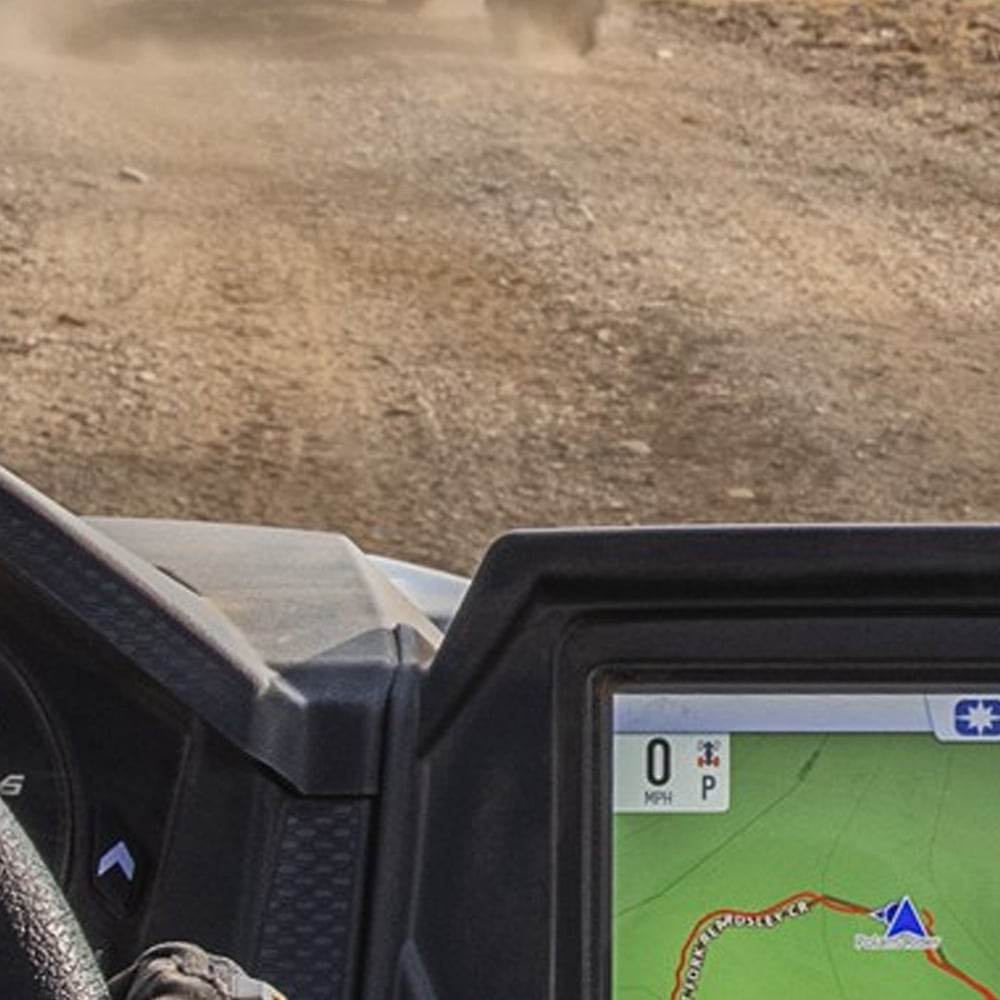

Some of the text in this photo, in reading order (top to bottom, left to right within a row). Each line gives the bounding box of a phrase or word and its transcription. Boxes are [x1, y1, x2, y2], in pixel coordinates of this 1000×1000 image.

[646, 738, 671, 786] 0
[644, 792, 672, 805] MPH
[702, 776, 716, 800] P
